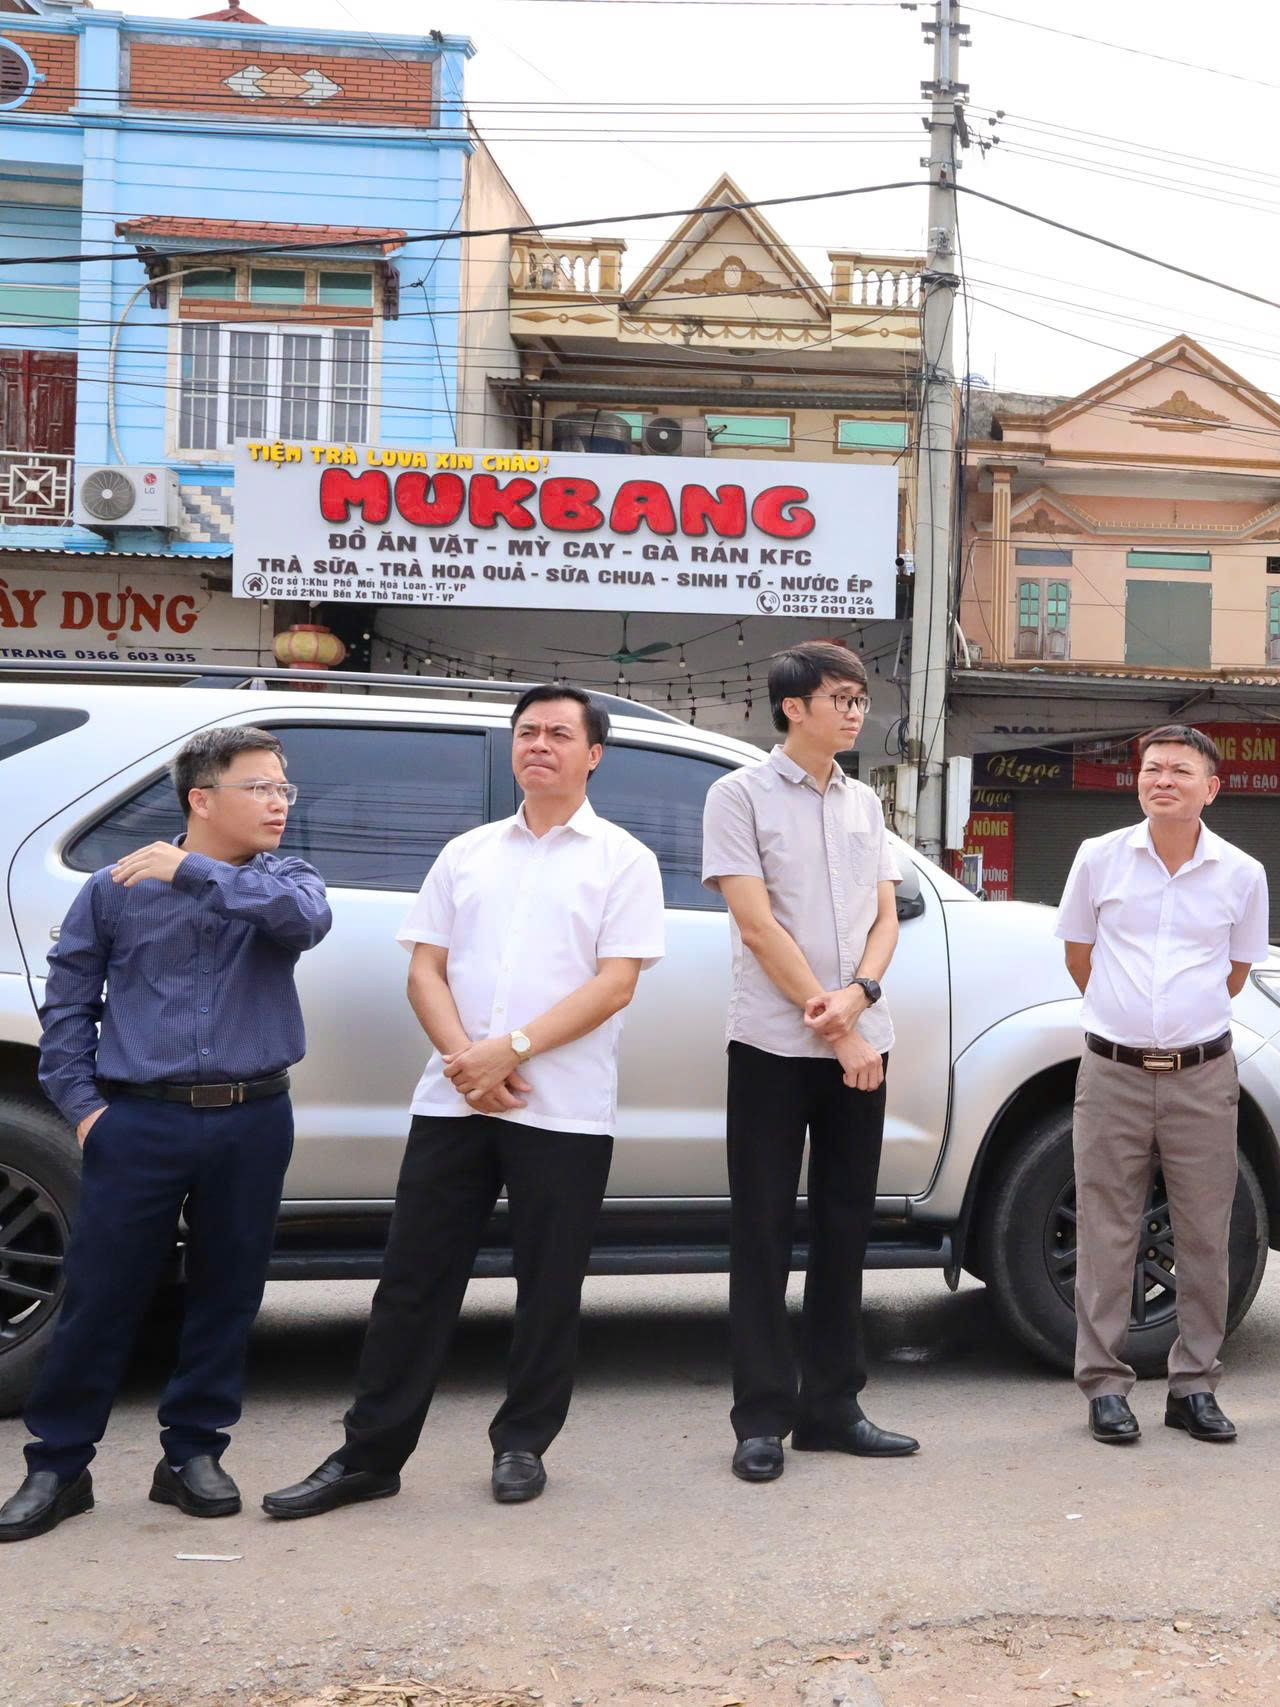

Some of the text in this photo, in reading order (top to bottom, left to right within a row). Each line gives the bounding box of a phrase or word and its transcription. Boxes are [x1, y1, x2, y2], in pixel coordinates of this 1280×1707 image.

[248, 441, 303, 468] TIỆM
[310, 443, 358, 465] TRÀ
[435, 452, 474, 470] XIN
[319, 467, 816, 540] MUKBANG
[329, 526, 366, 550] ĐỒ
[377, 531, 417, 552] ĂN
[429, 533, 479, 556] VẶT
[563, 541, 615, 559] CAY
[642, 537, 679, 562] GÀ
[691, 540, 749, 564] RÁN
[760, 549, 812, 566] KFC
[258, 555, 302, 573] TRÀ
[313, 556, 359, 575] SỮA
[380, 559, 423, 577] TRÀ
[432, 563, 475, 579] HOA
[483, 562, 526, 581] QUẢ
[546, 565, 589, 583] SỮA
[598, 570, 656, 585] CHUA
[676, 572, 728, 588] SINH
[736, 570, 763, 589] TỐ
[781, 573, 839, 591] NƯỚC
[847, 574, 873, 593] ÉP
[403, 581, 427, 590] Loan
[355, 591, 368, 599] Xe
[391, 592, 414, 601] Tang
[783, 594, 873, 605] 0375 230 124
[60, 586, 198, 641] DỰNG
[783, 604, 818, 613] 0367
[1, 648, 197, 663] TRANG 0366 603 035
[1242, 728, 1276, 761] SẢN
[973, 817, 1009, 836] NÔNG
